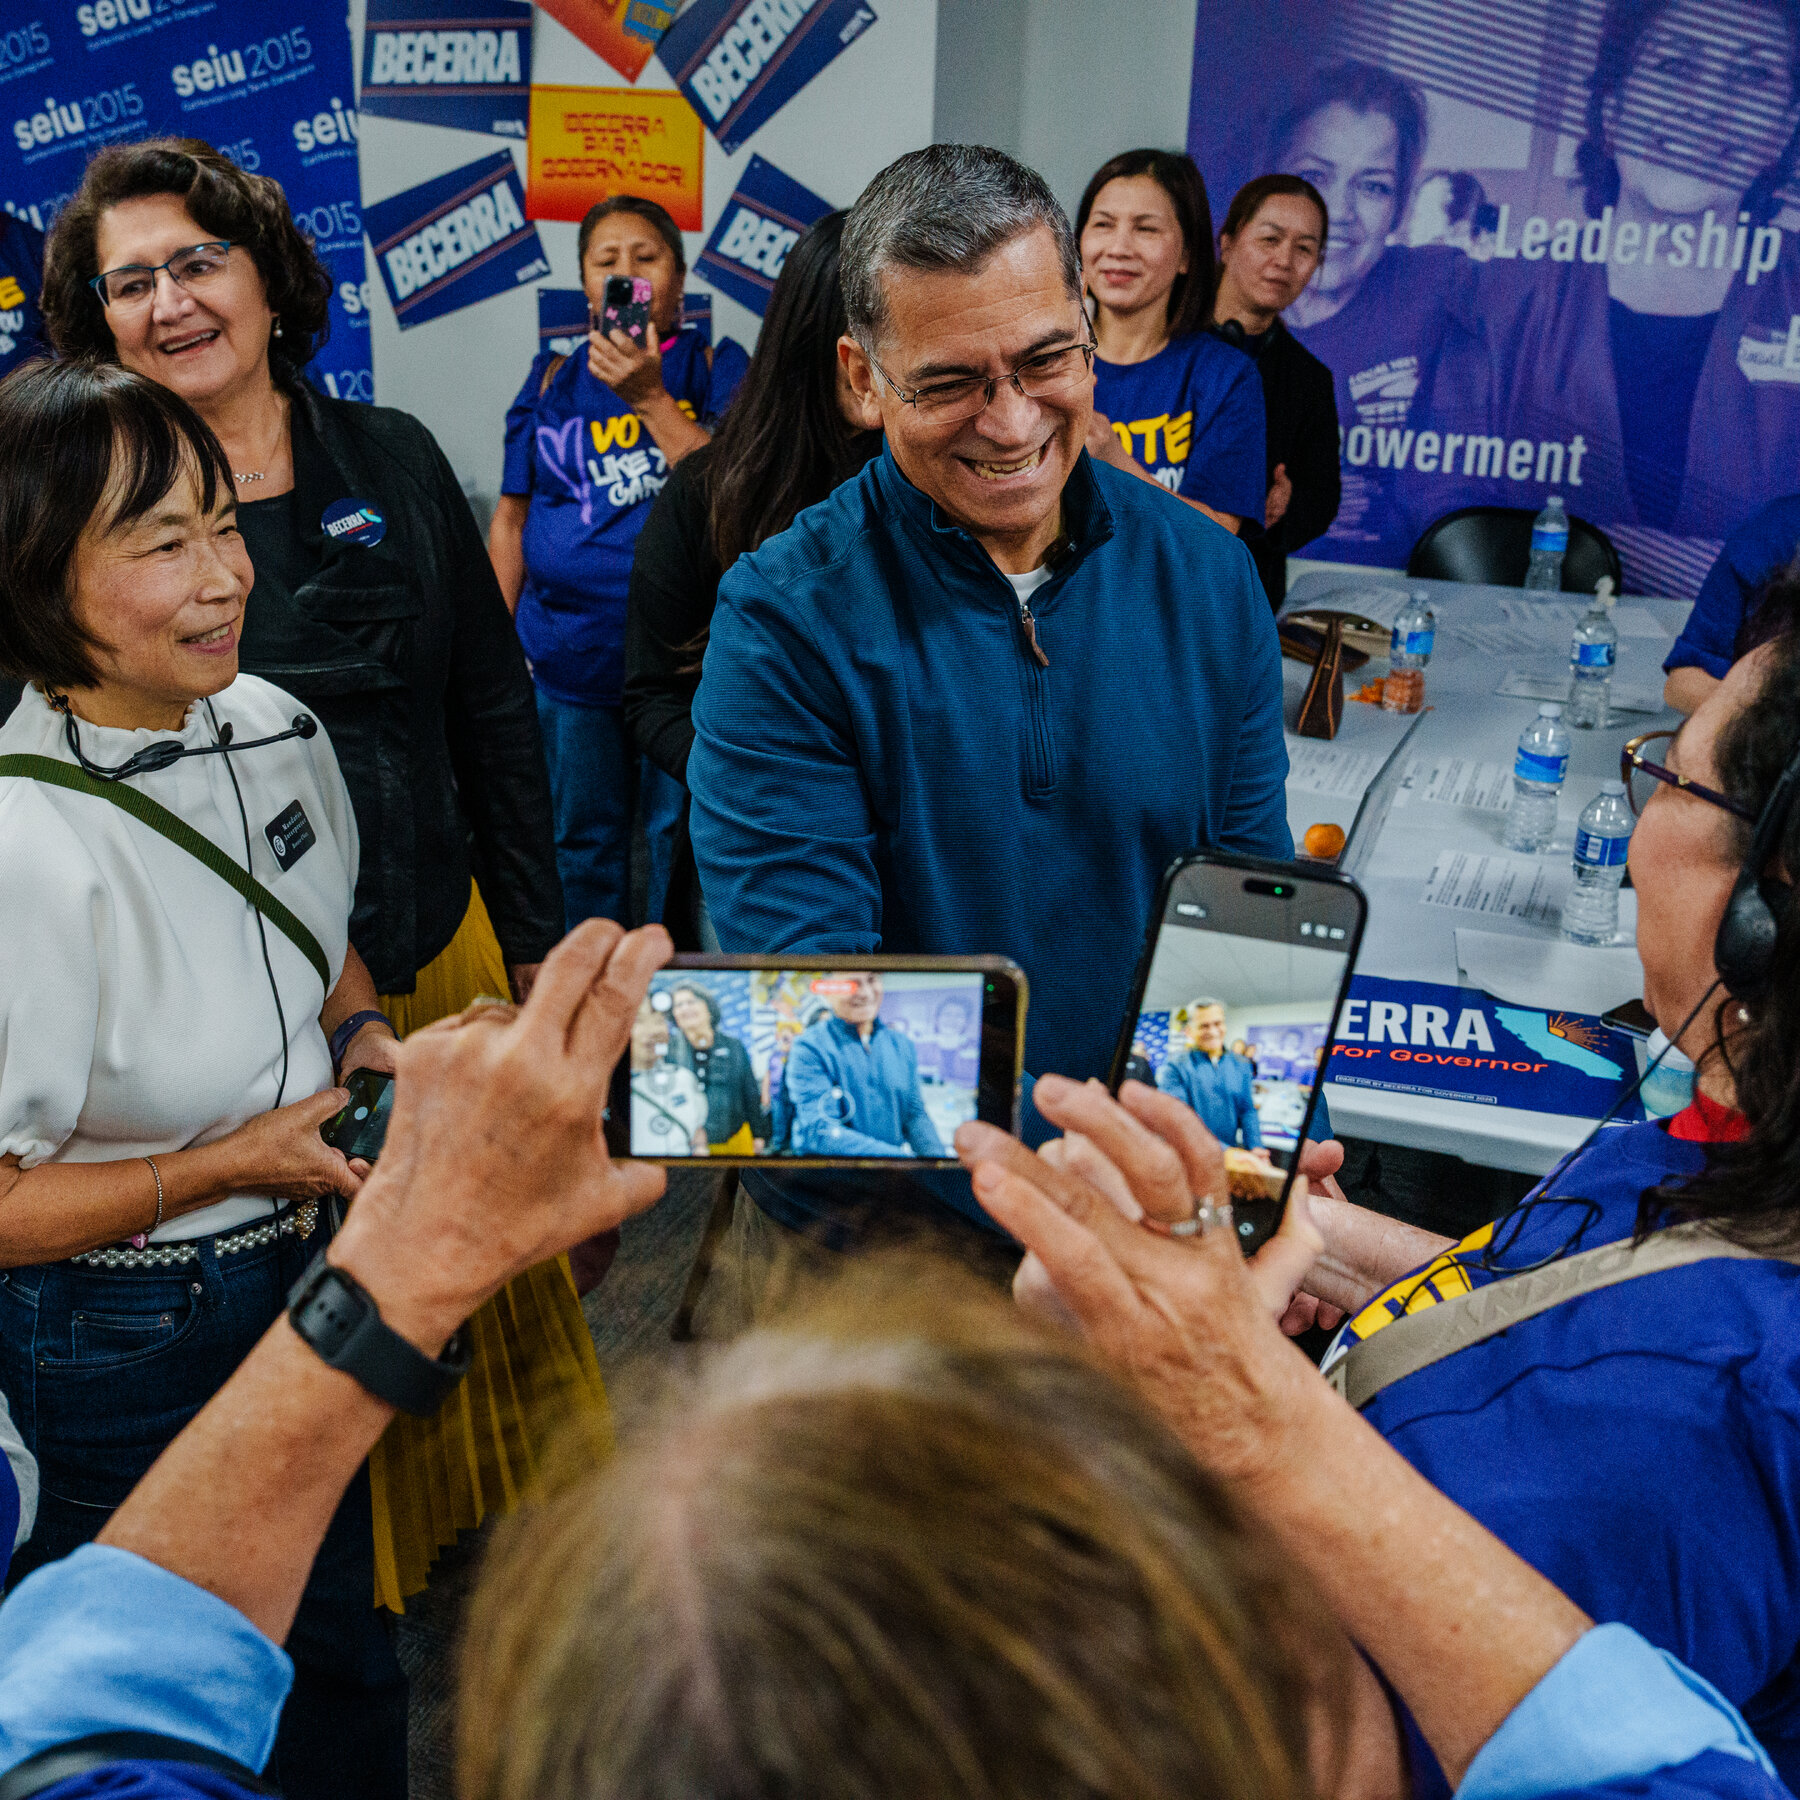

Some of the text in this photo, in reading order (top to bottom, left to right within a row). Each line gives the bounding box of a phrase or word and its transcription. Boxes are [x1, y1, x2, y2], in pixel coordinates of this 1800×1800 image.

[171, 44, 247, 98] seiu
[245, 25, 312, 79] 2015
[370, 29, 521, 84] BECERRA
[690, 0, 819, 122] BECER
[13, 97, 86, 150] seiu
[83, 82, 144, 130] 2015
[564, 113, 666, 136] BECERRA
[542, 158, 683, 186] GOBERNADOR
[585, 135, 641, 156] PARA
[386, 180, 525, 300] BECERRA
[1495, 205, 1782, 285] Leadership
[588, 449, 651, 487] LIKE
[1338, 424, 1586, 486] owerment
[326, 512, 366, 537] BECERRA
[1334, 998, 1496, 1053] ERRA
[1331, 1044, 1549, 1074] for Governor
